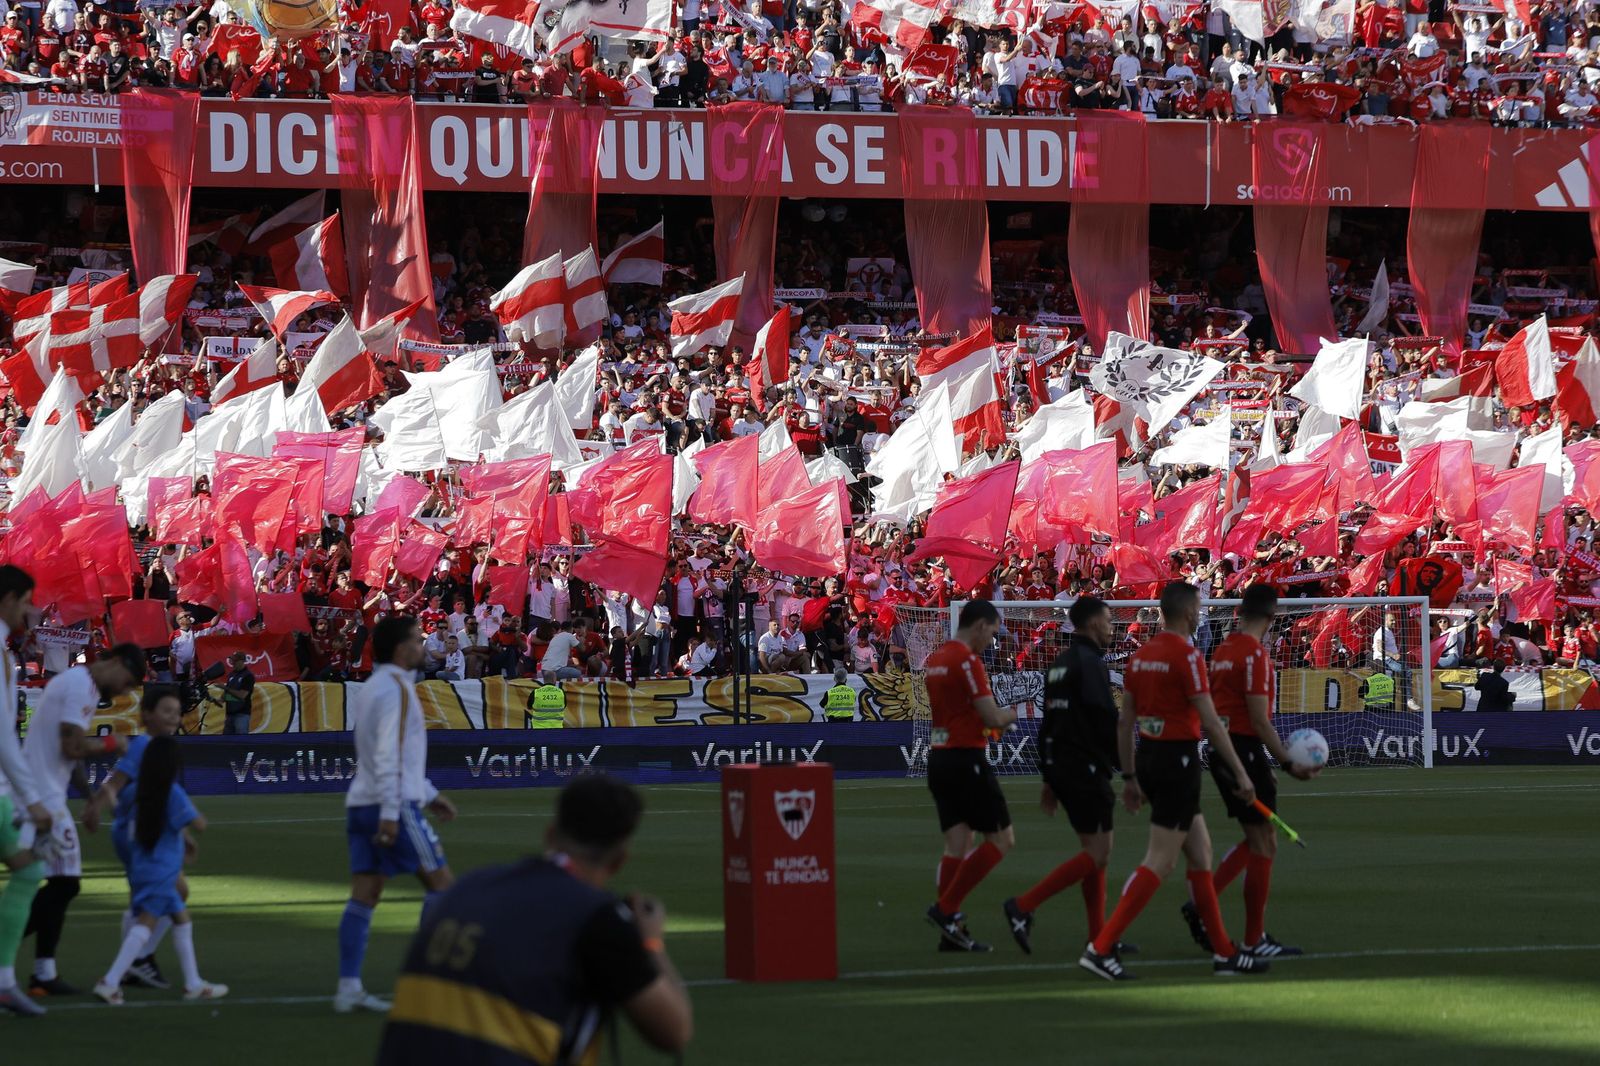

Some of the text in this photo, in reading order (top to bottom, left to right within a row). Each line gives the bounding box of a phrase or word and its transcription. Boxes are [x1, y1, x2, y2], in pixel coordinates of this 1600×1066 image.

[430, 115, 554, 185] QUE
[580, 118, 793, 183] NUNCA
[815, 124, 886, 184] SE
[922, 127, 1100, 189] RINDE
[465, 745, 601, 778] Varilux
[774, 856, 818, 871] NUNCA
[765, 870, 780, 884] TE
[783, 868, 830, 884] RINDAS
